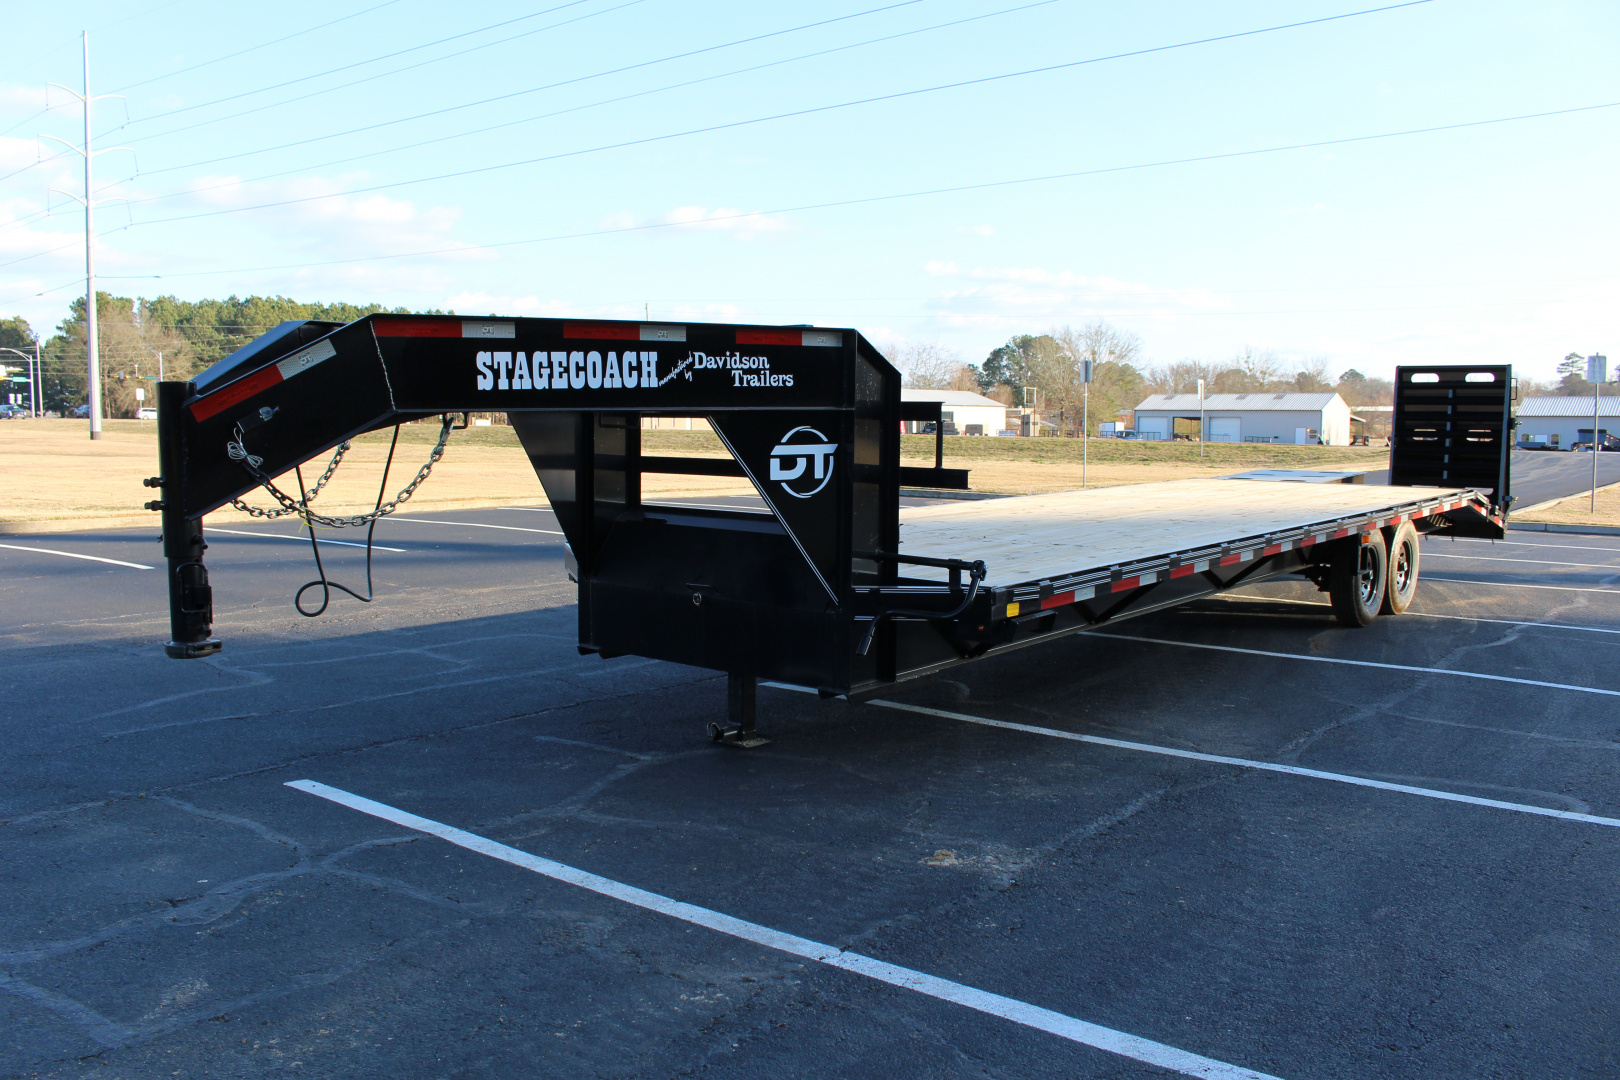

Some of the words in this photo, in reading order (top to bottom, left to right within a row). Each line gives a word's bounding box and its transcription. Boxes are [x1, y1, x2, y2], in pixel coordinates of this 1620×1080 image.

[692, 350, 770, 370] Davidson
[476, 351, 659, 391] STAGECOACH
[684, 368, 693, 382] by
[731, 369, 794, 387] Trailers
